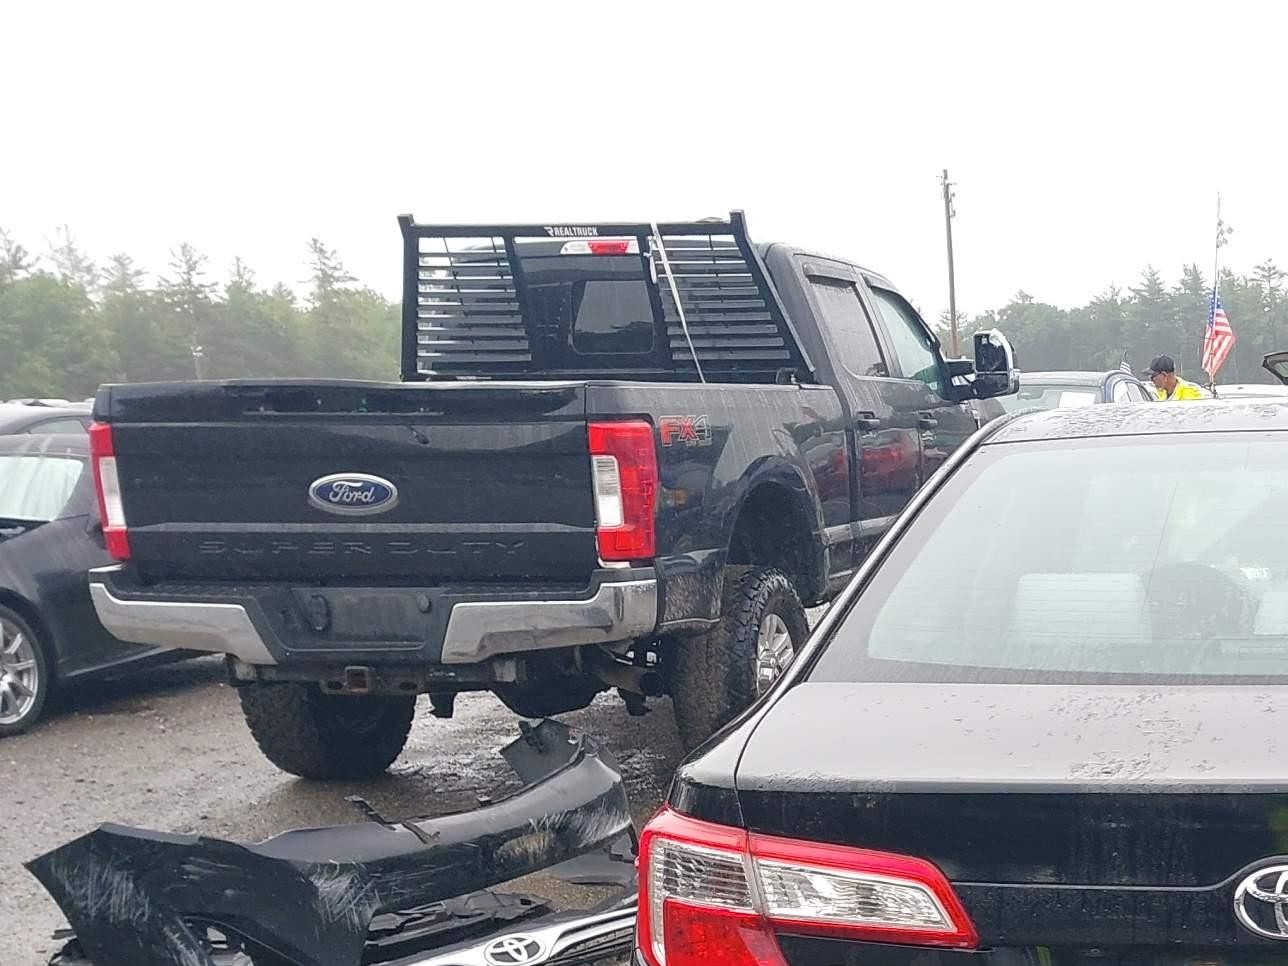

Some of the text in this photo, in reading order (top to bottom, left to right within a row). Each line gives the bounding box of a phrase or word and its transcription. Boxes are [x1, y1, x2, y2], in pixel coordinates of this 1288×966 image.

[554, 226, 599, 236] REALTRUCK
[659, 415, 712, 447] FX4
[329, 480, 375, 502] Ford
